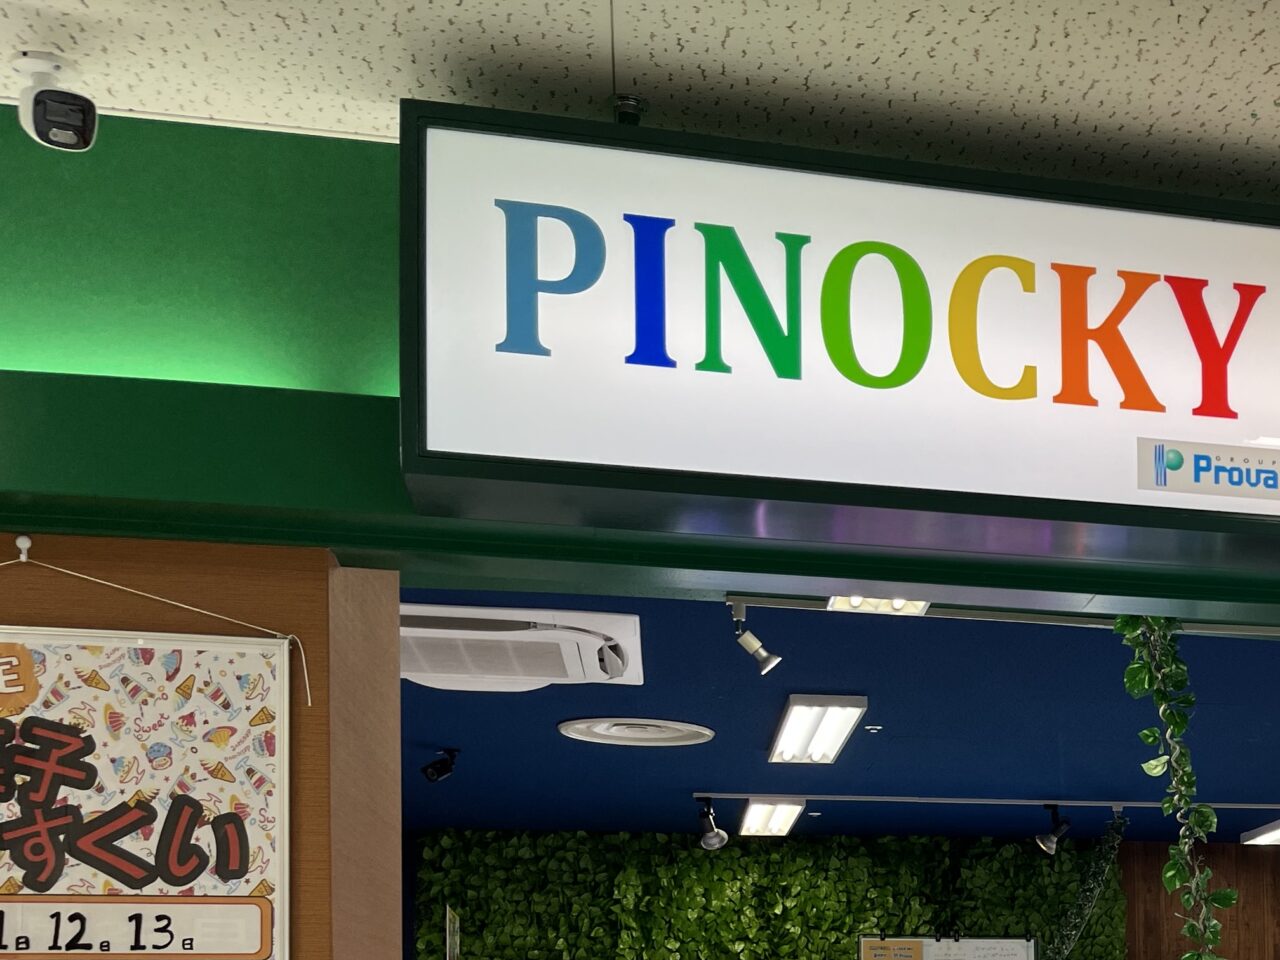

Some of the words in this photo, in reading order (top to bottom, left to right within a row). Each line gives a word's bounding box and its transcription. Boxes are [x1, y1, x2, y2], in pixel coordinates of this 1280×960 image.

[494, 198, 1267, 418] PINOCKY
[1193, 453, 1279, 490] Prova
[1215, 455, 1277, 465] GROUP
